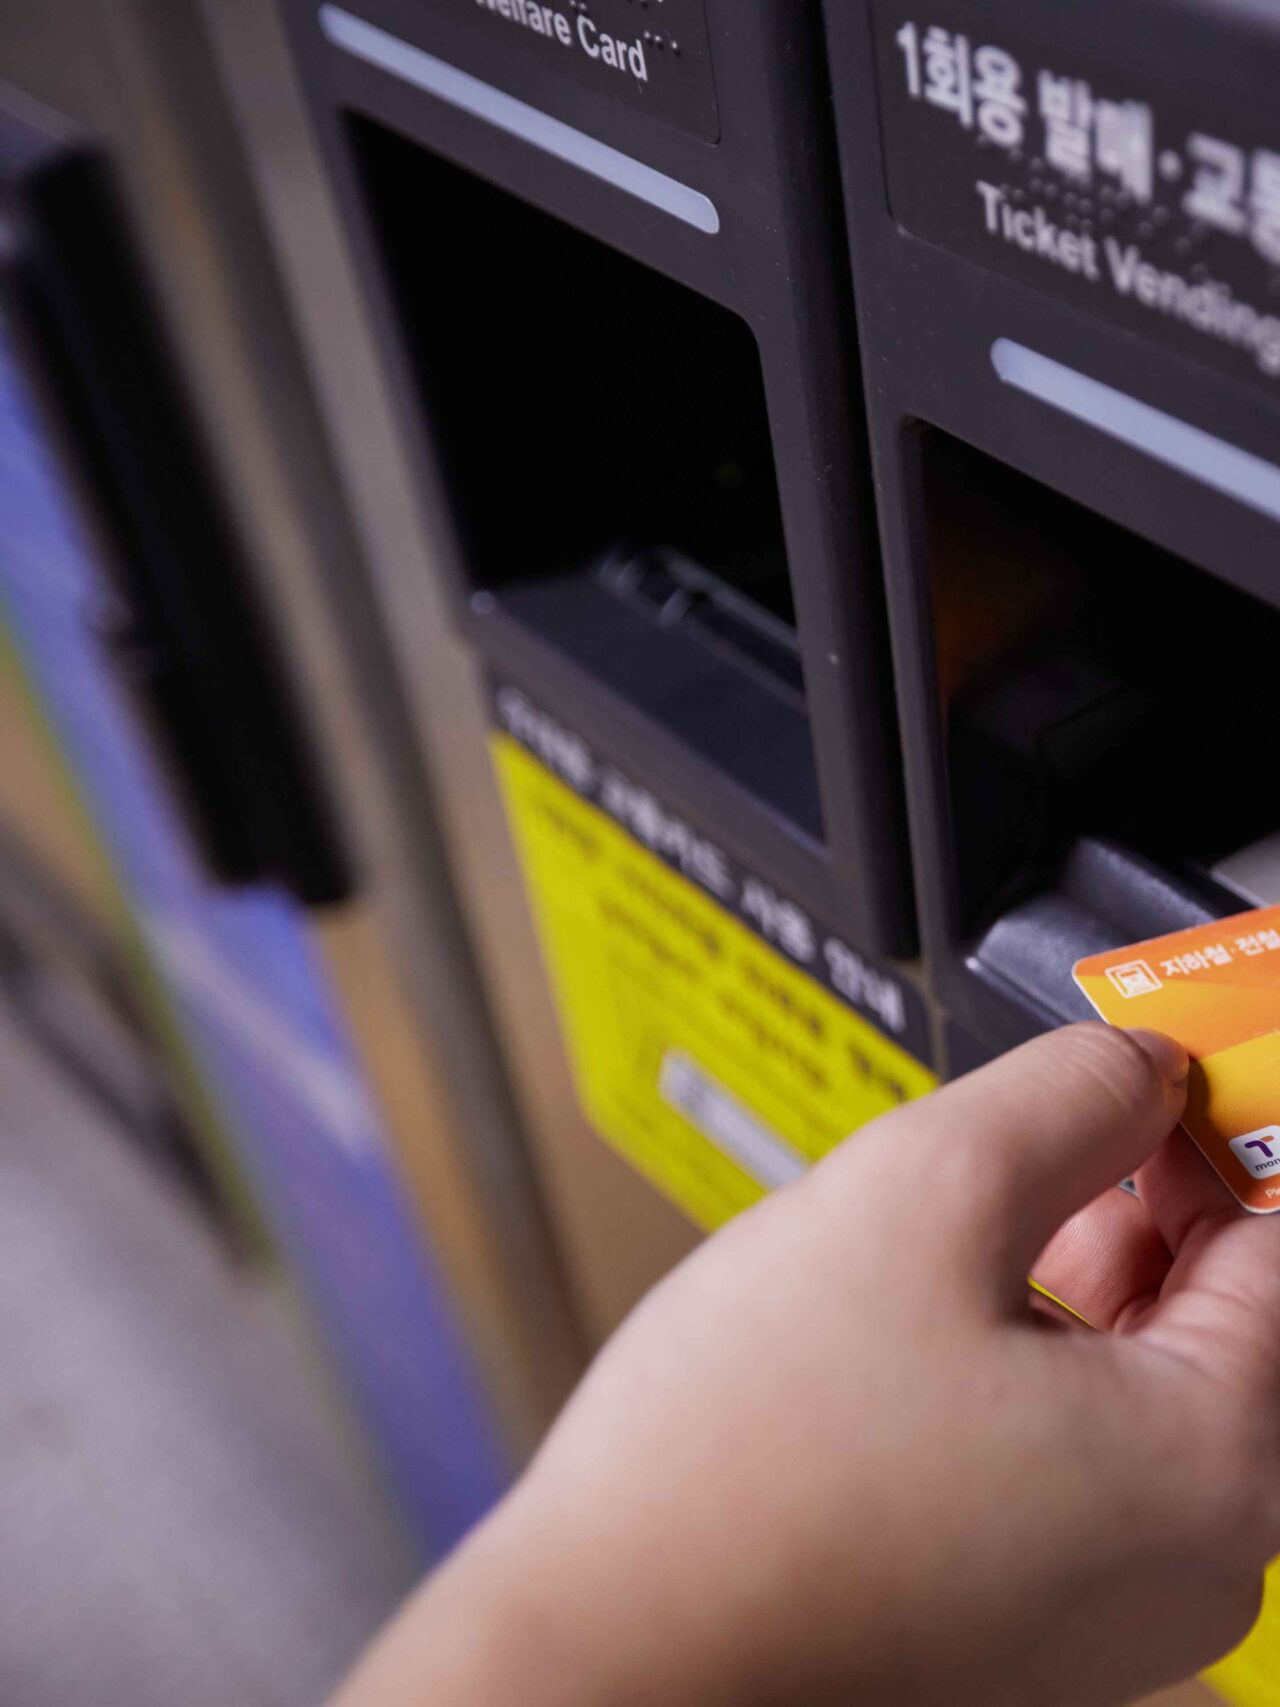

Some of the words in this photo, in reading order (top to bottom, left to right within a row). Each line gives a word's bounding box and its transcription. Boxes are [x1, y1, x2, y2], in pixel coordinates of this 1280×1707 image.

[475, 0, 572, 45] elfare
[575, 14, 649, 81] Card
[896, 20, 1026, 148] 1회용
[976, 180, 1100, 281] Ticket
